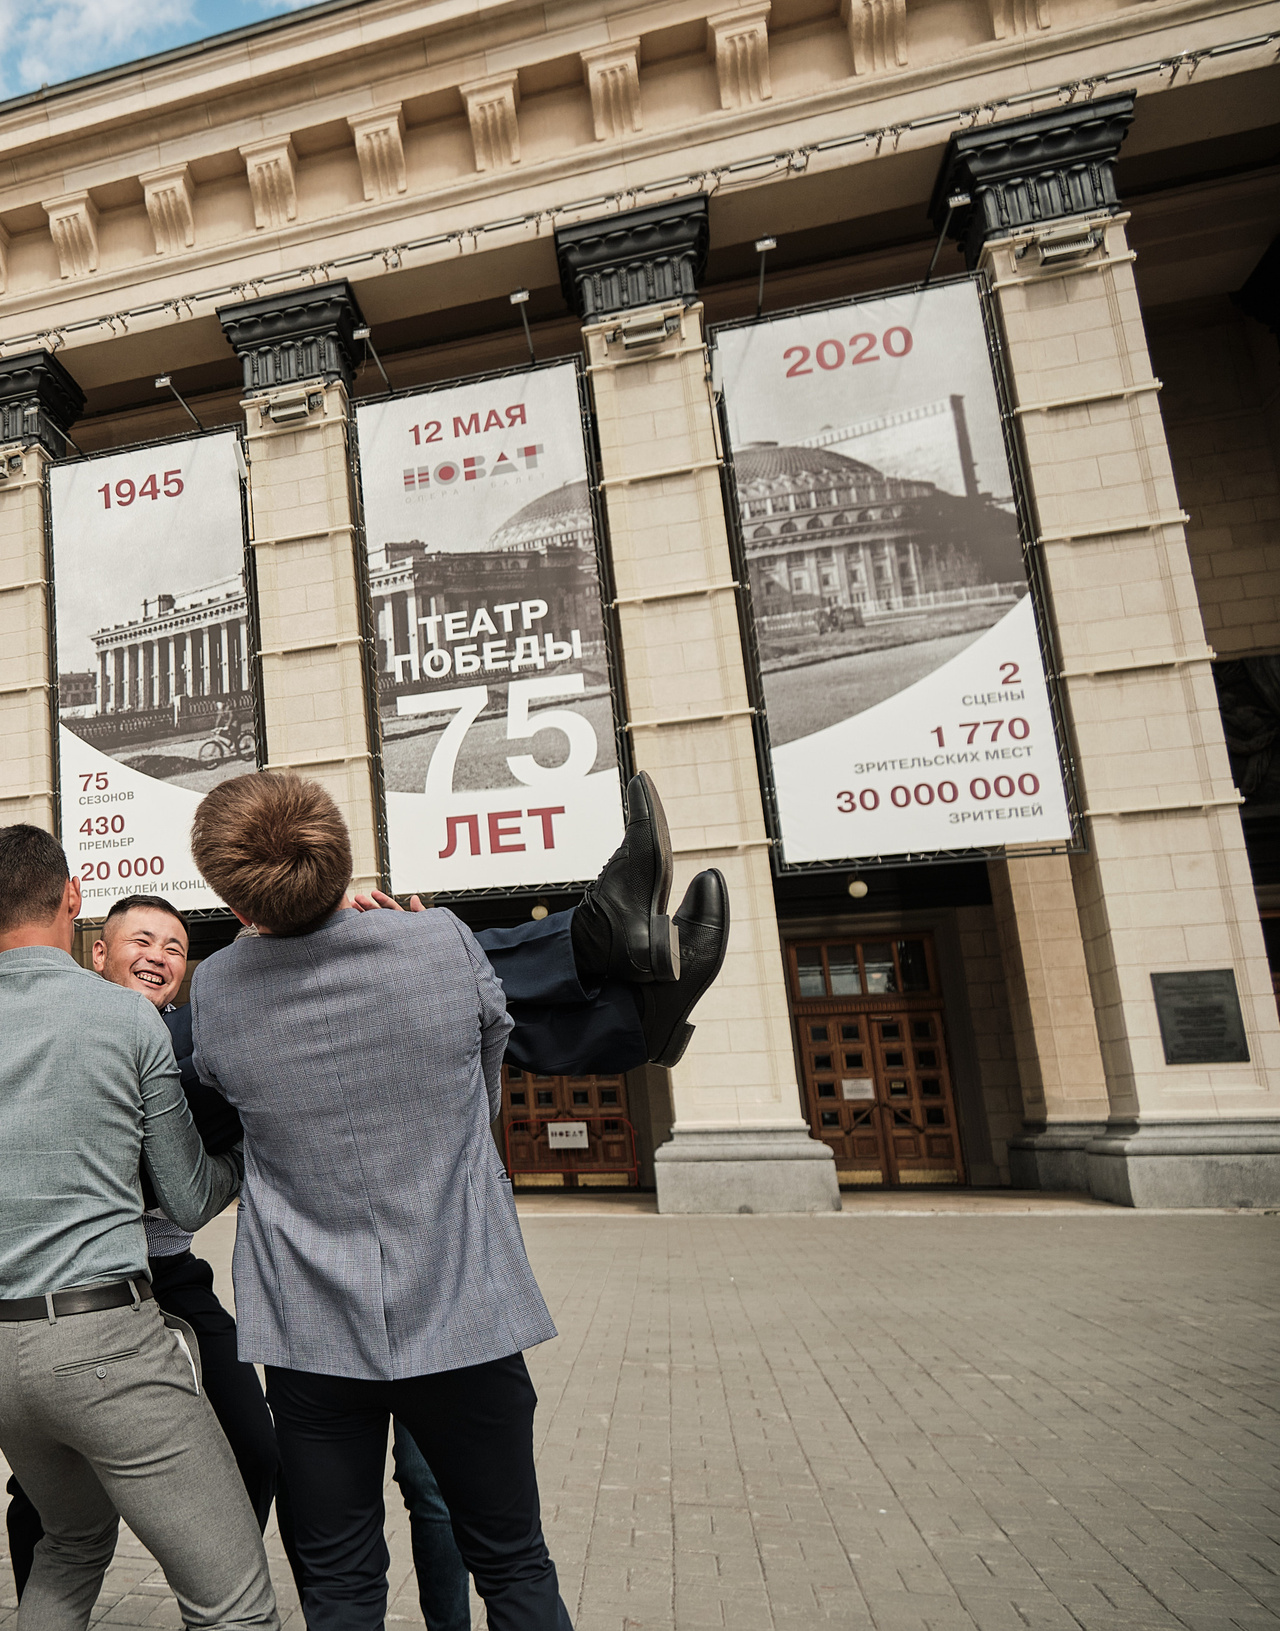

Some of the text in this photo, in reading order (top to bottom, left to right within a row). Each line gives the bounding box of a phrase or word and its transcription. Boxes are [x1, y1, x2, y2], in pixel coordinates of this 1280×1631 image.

[783, 325, 913, 378] 2020
[408, 403, 527, 446] 12 МАЯ
[403, 443, 545, 492] НОВАТ
[97, 469, 184, 510] 1945
[418, 599, 549, 644] ТЕАТР
[394, 629, 582, 683] ПОБЕДЫ
[999, 662, 1022, 685] 2
[961, 690, 1025, 706] СЦЕНЫ
[396, 673, 598, 795] 75
[930, 717, 1030, 748] 1 770
[854, 745, 1034, 774] ЗРИТЕЛЬСКИХ МЕСТ
[79, 772, 109, 792] 75
[836, 773, 1040, 813] 30 000 000
[78, 791, 135, 806] СЕЗОНОВ
[949, 802, 1044, 824] ЗРИТЕЛЕЙ
[79, 815, 125, 836] 430
[438, 806, 565, 859] ЛЕТ
[79, 837, 135, 851] ПРЕМЬЕР
[81, 856, 164, 882] 20 000
[81, 881, 158, 899] СПЕКТАКЛЕЙ
[160, 882, 169, 892] И
